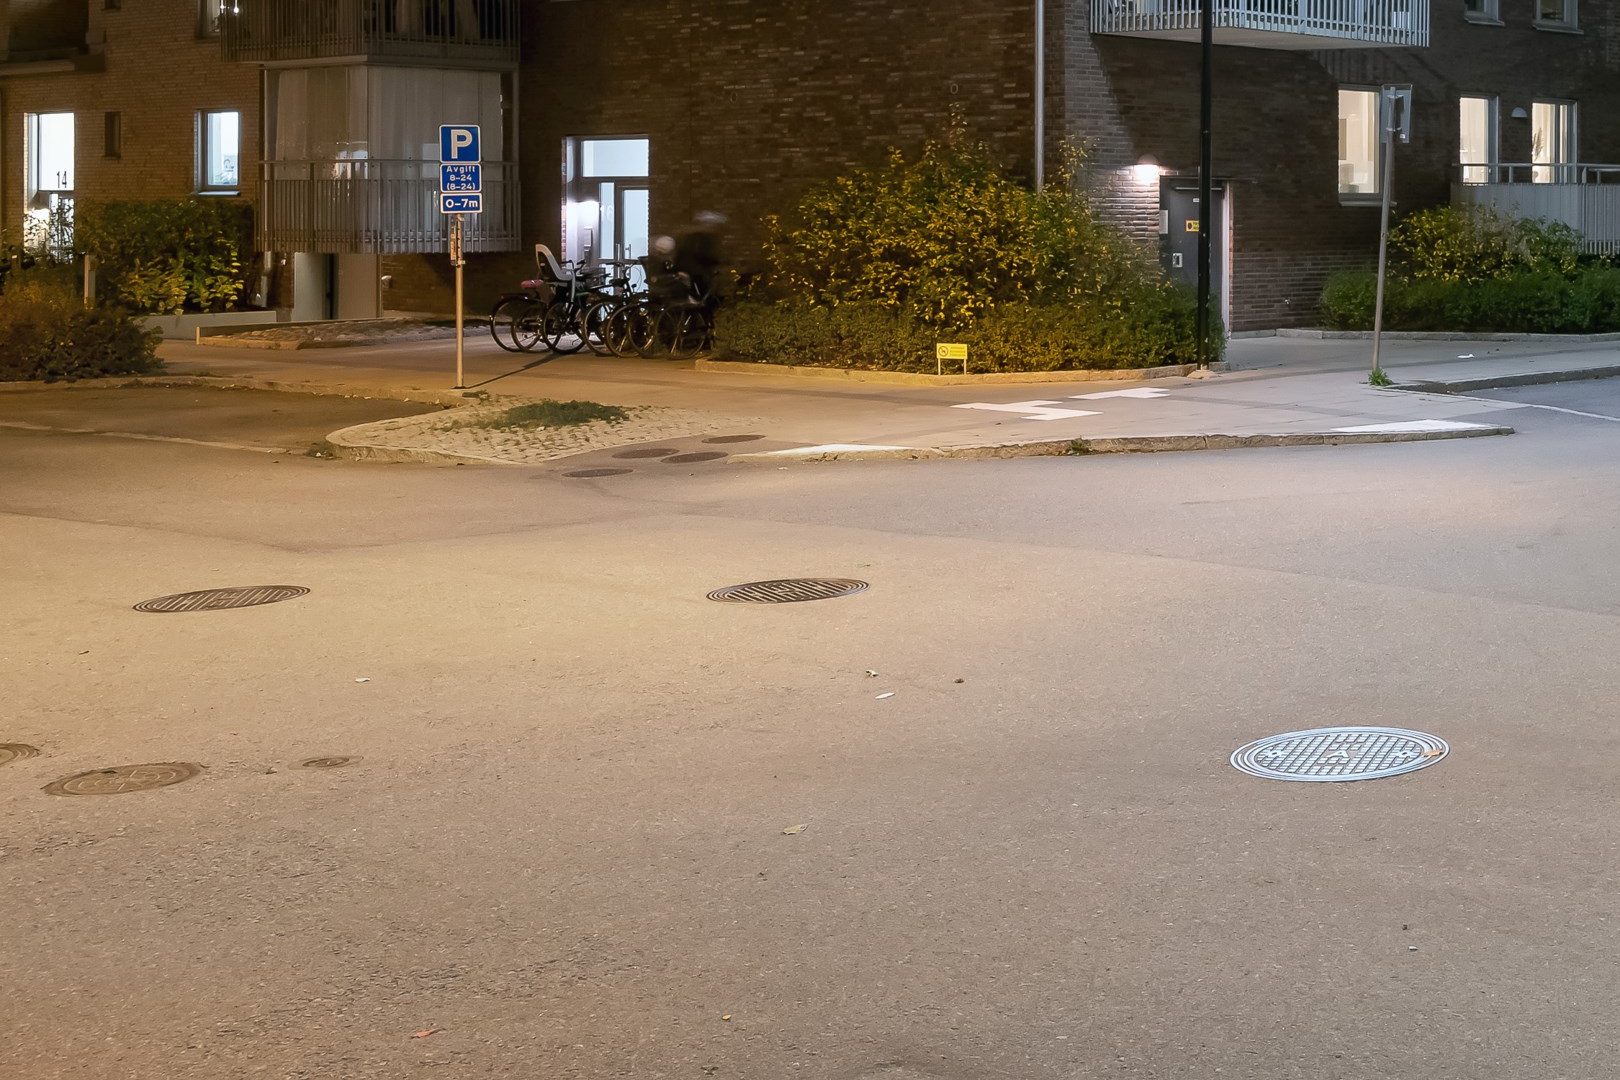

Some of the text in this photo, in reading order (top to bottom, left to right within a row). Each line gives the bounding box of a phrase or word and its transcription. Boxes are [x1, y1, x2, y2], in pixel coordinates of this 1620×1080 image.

[450, 128, 473, 160] P
[446, 165, 476, 174] Avgift
[56, 170, 68, 189] 14
[449, 174, 472, 182] 8-24
[446, 182, 476, 191] (8-24)
[445, 198, 479, 209] 0-7m
